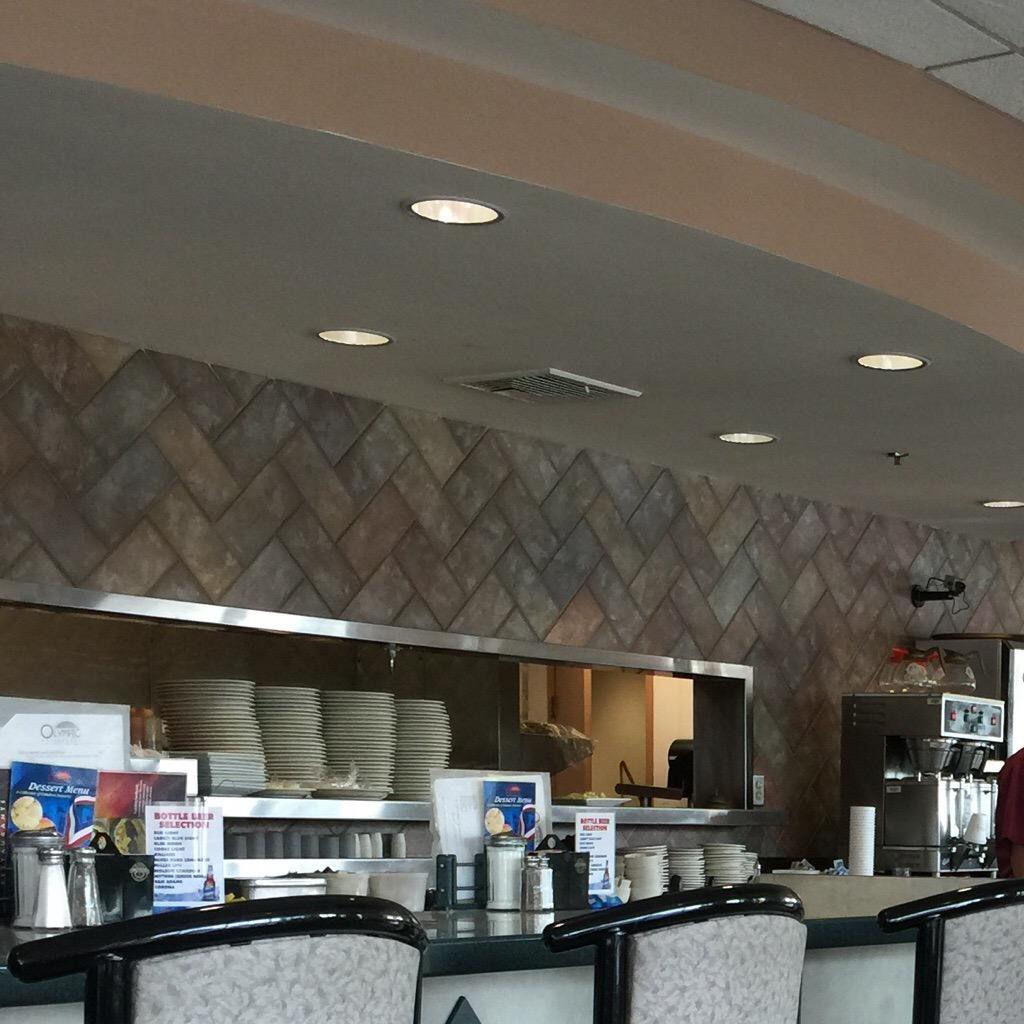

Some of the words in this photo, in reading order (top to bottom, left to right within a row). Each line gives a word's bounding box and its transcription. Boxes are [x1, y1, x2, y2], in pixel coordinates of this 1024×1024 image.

[28, 781, 63, 793] Dessert
[65, 785, 90, 795] Menu
[154, 812, 188, 820] BOTTLE
[191, 812, 214, 820] BEER
[159, 821, 210, 829] SELECTION
